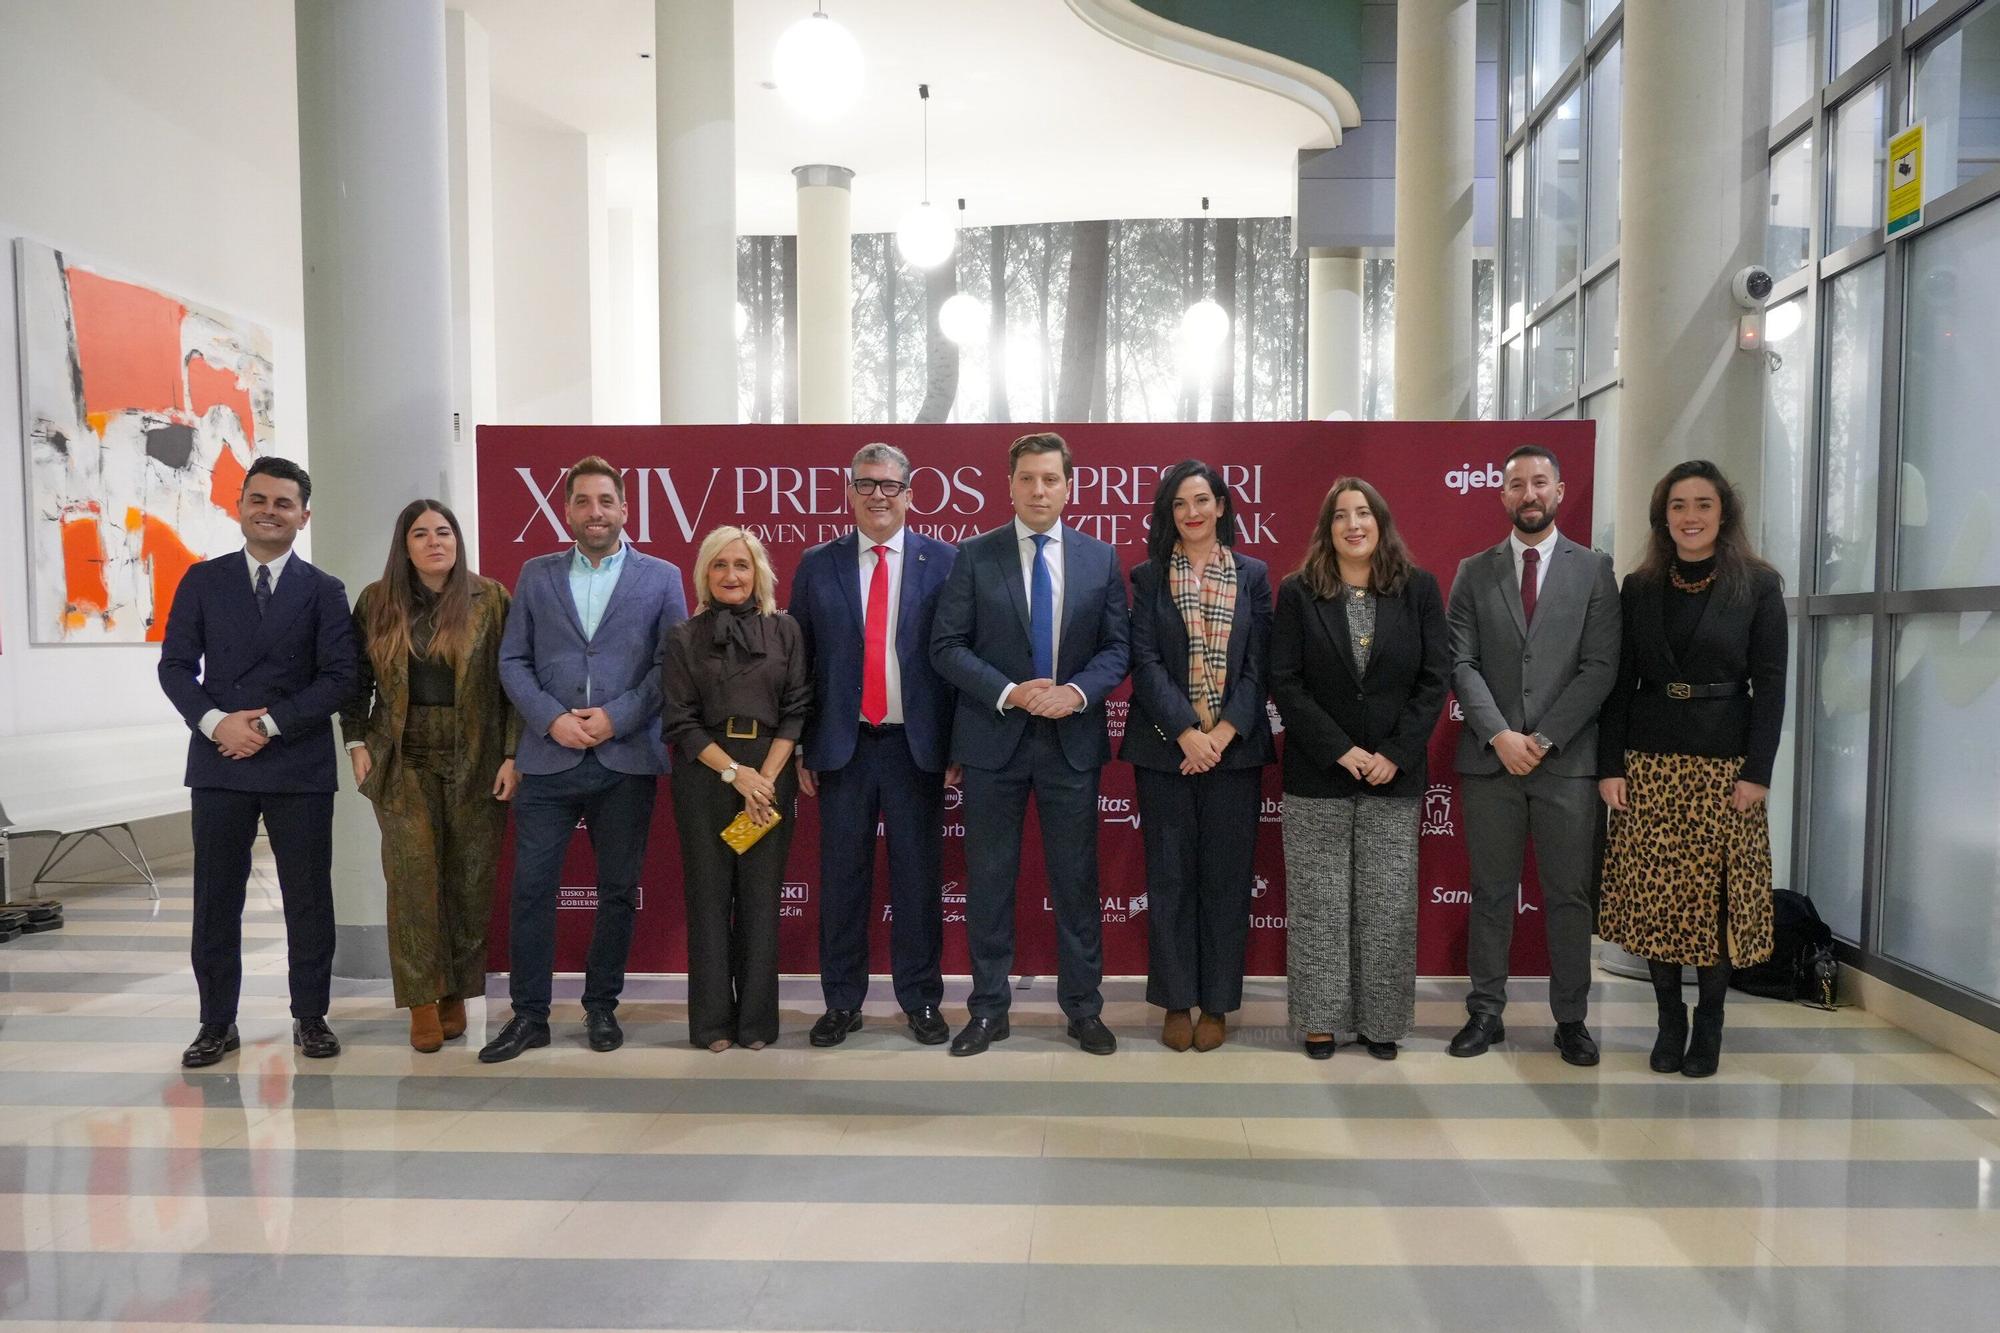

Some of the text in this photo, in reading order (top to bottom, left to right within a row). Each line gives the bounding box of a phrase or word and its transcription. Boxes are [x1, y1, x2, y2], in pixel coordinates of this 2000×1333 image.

[735, 466, 985, 515] PREOS
[1444, 463, 1504, 495] ajeb
[513, 467, 721, 543] XIV
[1067, 514, 1132, 545] ZTE
[1097, 795, 1131, 811] itas
[779, 905, 803, 917] ekin
